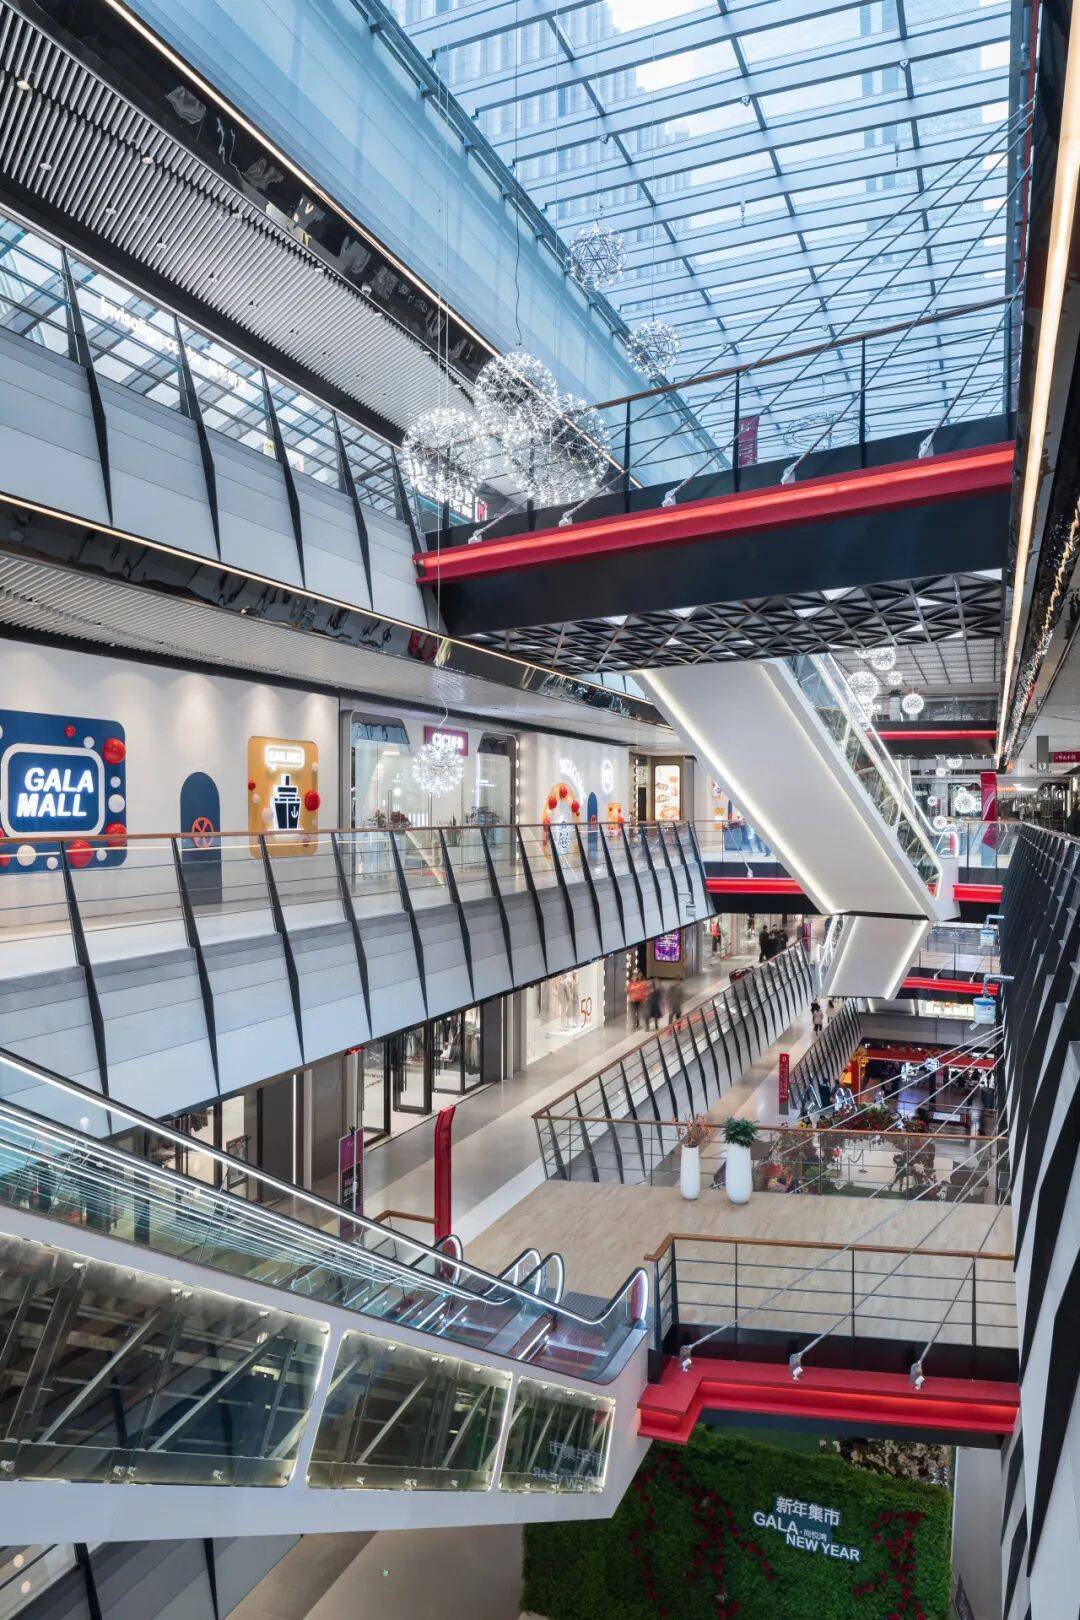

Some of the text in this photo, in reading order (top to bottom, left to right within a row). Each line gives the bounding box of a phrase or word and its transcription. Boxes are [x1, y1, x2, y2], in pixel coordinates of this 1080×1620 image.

[24, 767, 94, 793] GALA
[16, 792, 87, 817] MALL
[753, 1511, 798, 1535] GALA
[776, 1496, 840, 1526] 新年集市
[786, 1533, 860, 1561] NEW YEAR
